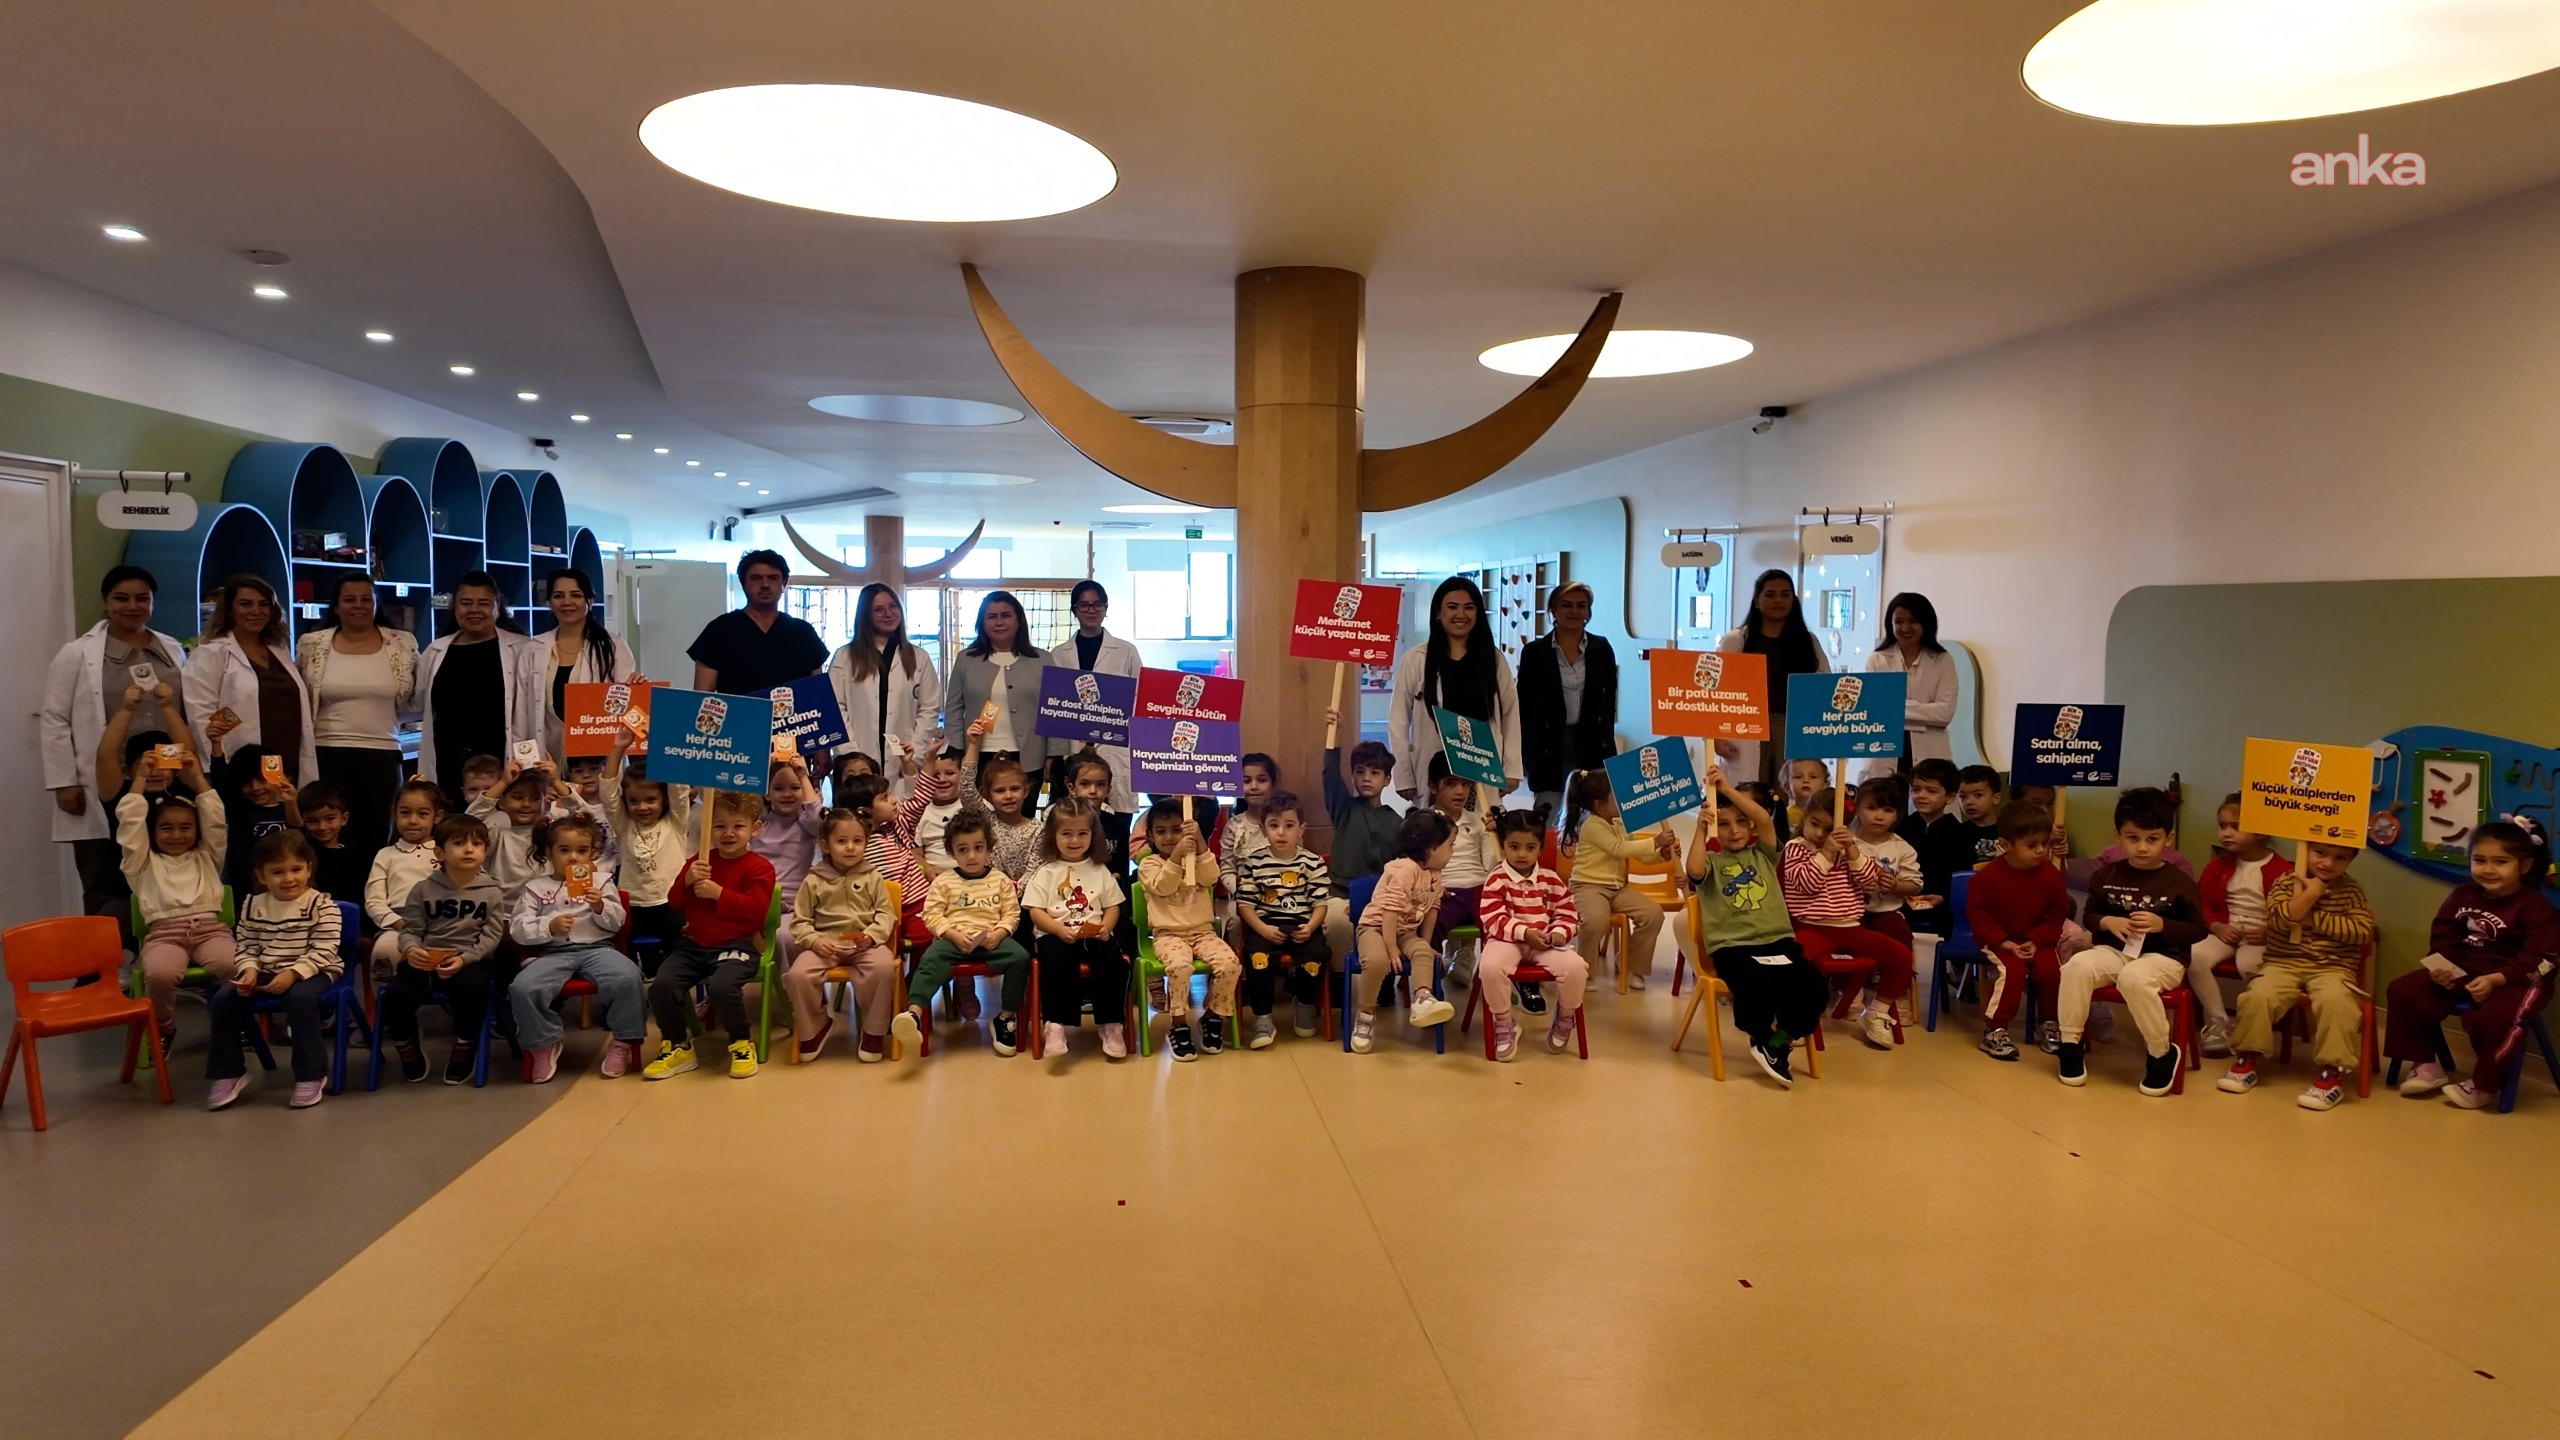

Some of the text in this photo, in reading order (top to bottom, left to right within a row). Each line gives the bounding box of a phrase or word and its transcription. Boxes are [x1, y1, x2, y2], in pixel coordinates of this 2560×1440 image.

[122, 504, 170, 515] REHBERLİK
[1830, 533, 1854, 543] VENÜS
[1317, 615, 1371, 629] Merhamet
[1295, 625, 1391, 642] küçük yaşta başlar.
[1668, 686, 1749, 702] Bir pati uzanır,
[703, 703, 726, 714] HAYVAN
[1040, 706, 1078, 719] hayatını
[1047, 697, 1124, 716] Bir dost sahiplen,
[1146, 702, 1227, 720] Sevgimiz bütün
[1657, 698, 1760, 716] bir dostluk başlar.
[580, 715, 595, 724] Bir
[595, 714, 617, 726] pati
[787, 709, 822, 725] alma,
[1822, 710, 1867, 723] Her pati
[570, 726, 620, 735] bir dostlu
[1802, 723, 1886, 736] sevgiyle büyür.
[685, 733, 732, 748] Her pati
[2030, 738, 2102, 751] Satın alma,
[664, 746, 751, 764] sevgiyle büyür.
[1190, 752, 1238, 763] korumak
[2036, 752, 2095, 766] sahiplen!
[2296, 754, 2319, 765] HAYVAN
[2303, 749, 2315, 757] BEN
[1141, 760, 1230, 774] hepimizin görevi.
[1632, 773, 1674, 794] Bir kap su,
[1620, 791, 1660, 811] kocaman
[1659, 785, 1671, 796] bir
[2251, 781, 2356, 803] Küçük kalplerden
[2264, 796, 2340, 817] büyük sevgi!
[423, 899, 488, 921] USPA
[2481, 911, 2507, 929] KITTY
